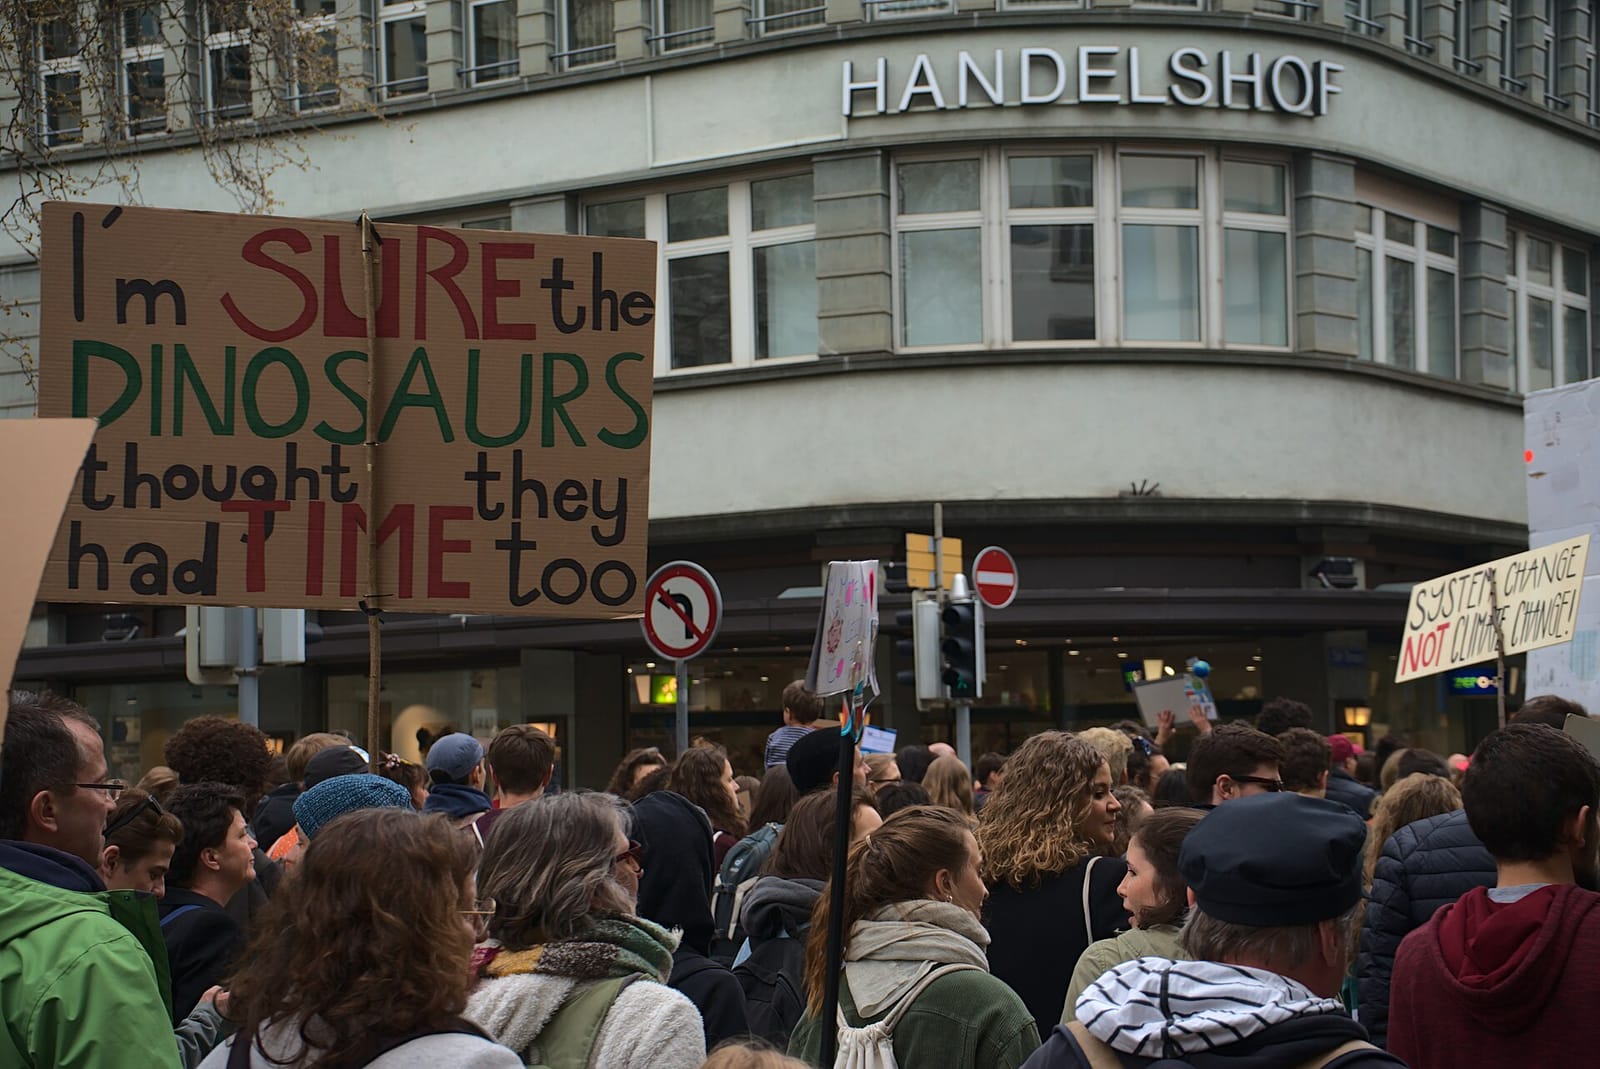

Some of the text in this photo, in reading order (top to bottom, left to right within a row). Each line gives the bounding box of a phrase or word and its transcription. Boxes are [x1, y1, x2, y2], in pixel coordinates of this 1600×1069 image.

[842, 46, 1344, 117] HANDELSHOF
[220, 226, 536, 342] SURE
[541, 252, 655, 334] the
[72, 340, 648, 449] DINOSAURS
[80, 441, 627, 546] thought they
[67, 500, 636, 606] had TIME too
[1504, 545, 1582, 597] CHANGE
[1401, 622, 1450, 676] NOT
[1511, 589, 1577, 647] CHANGE!
